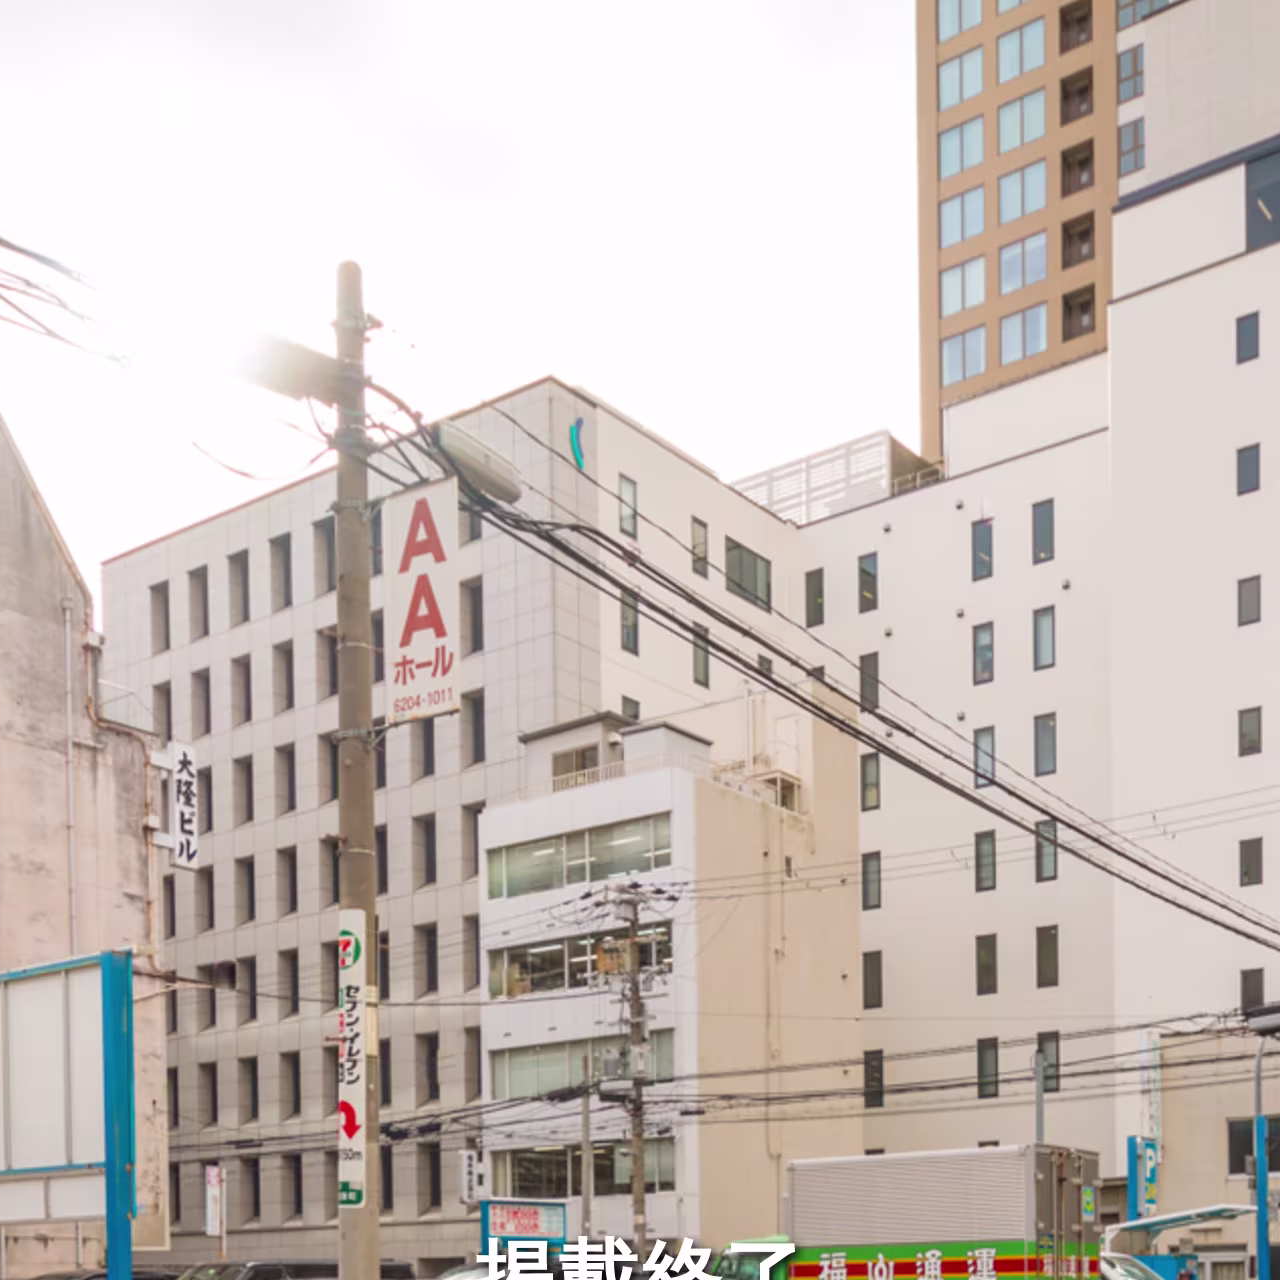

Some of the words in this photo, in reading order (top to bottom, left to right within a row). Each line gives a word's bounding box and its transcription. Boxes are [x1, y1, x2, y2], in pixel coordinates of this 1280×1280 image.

[393, 645, 454, 687] ホール
[393, 686, 453, 713] 6204-1011
[175, 750, 198, 863] 大隆ビル
[1145, 1147, 1156, 1178] P
